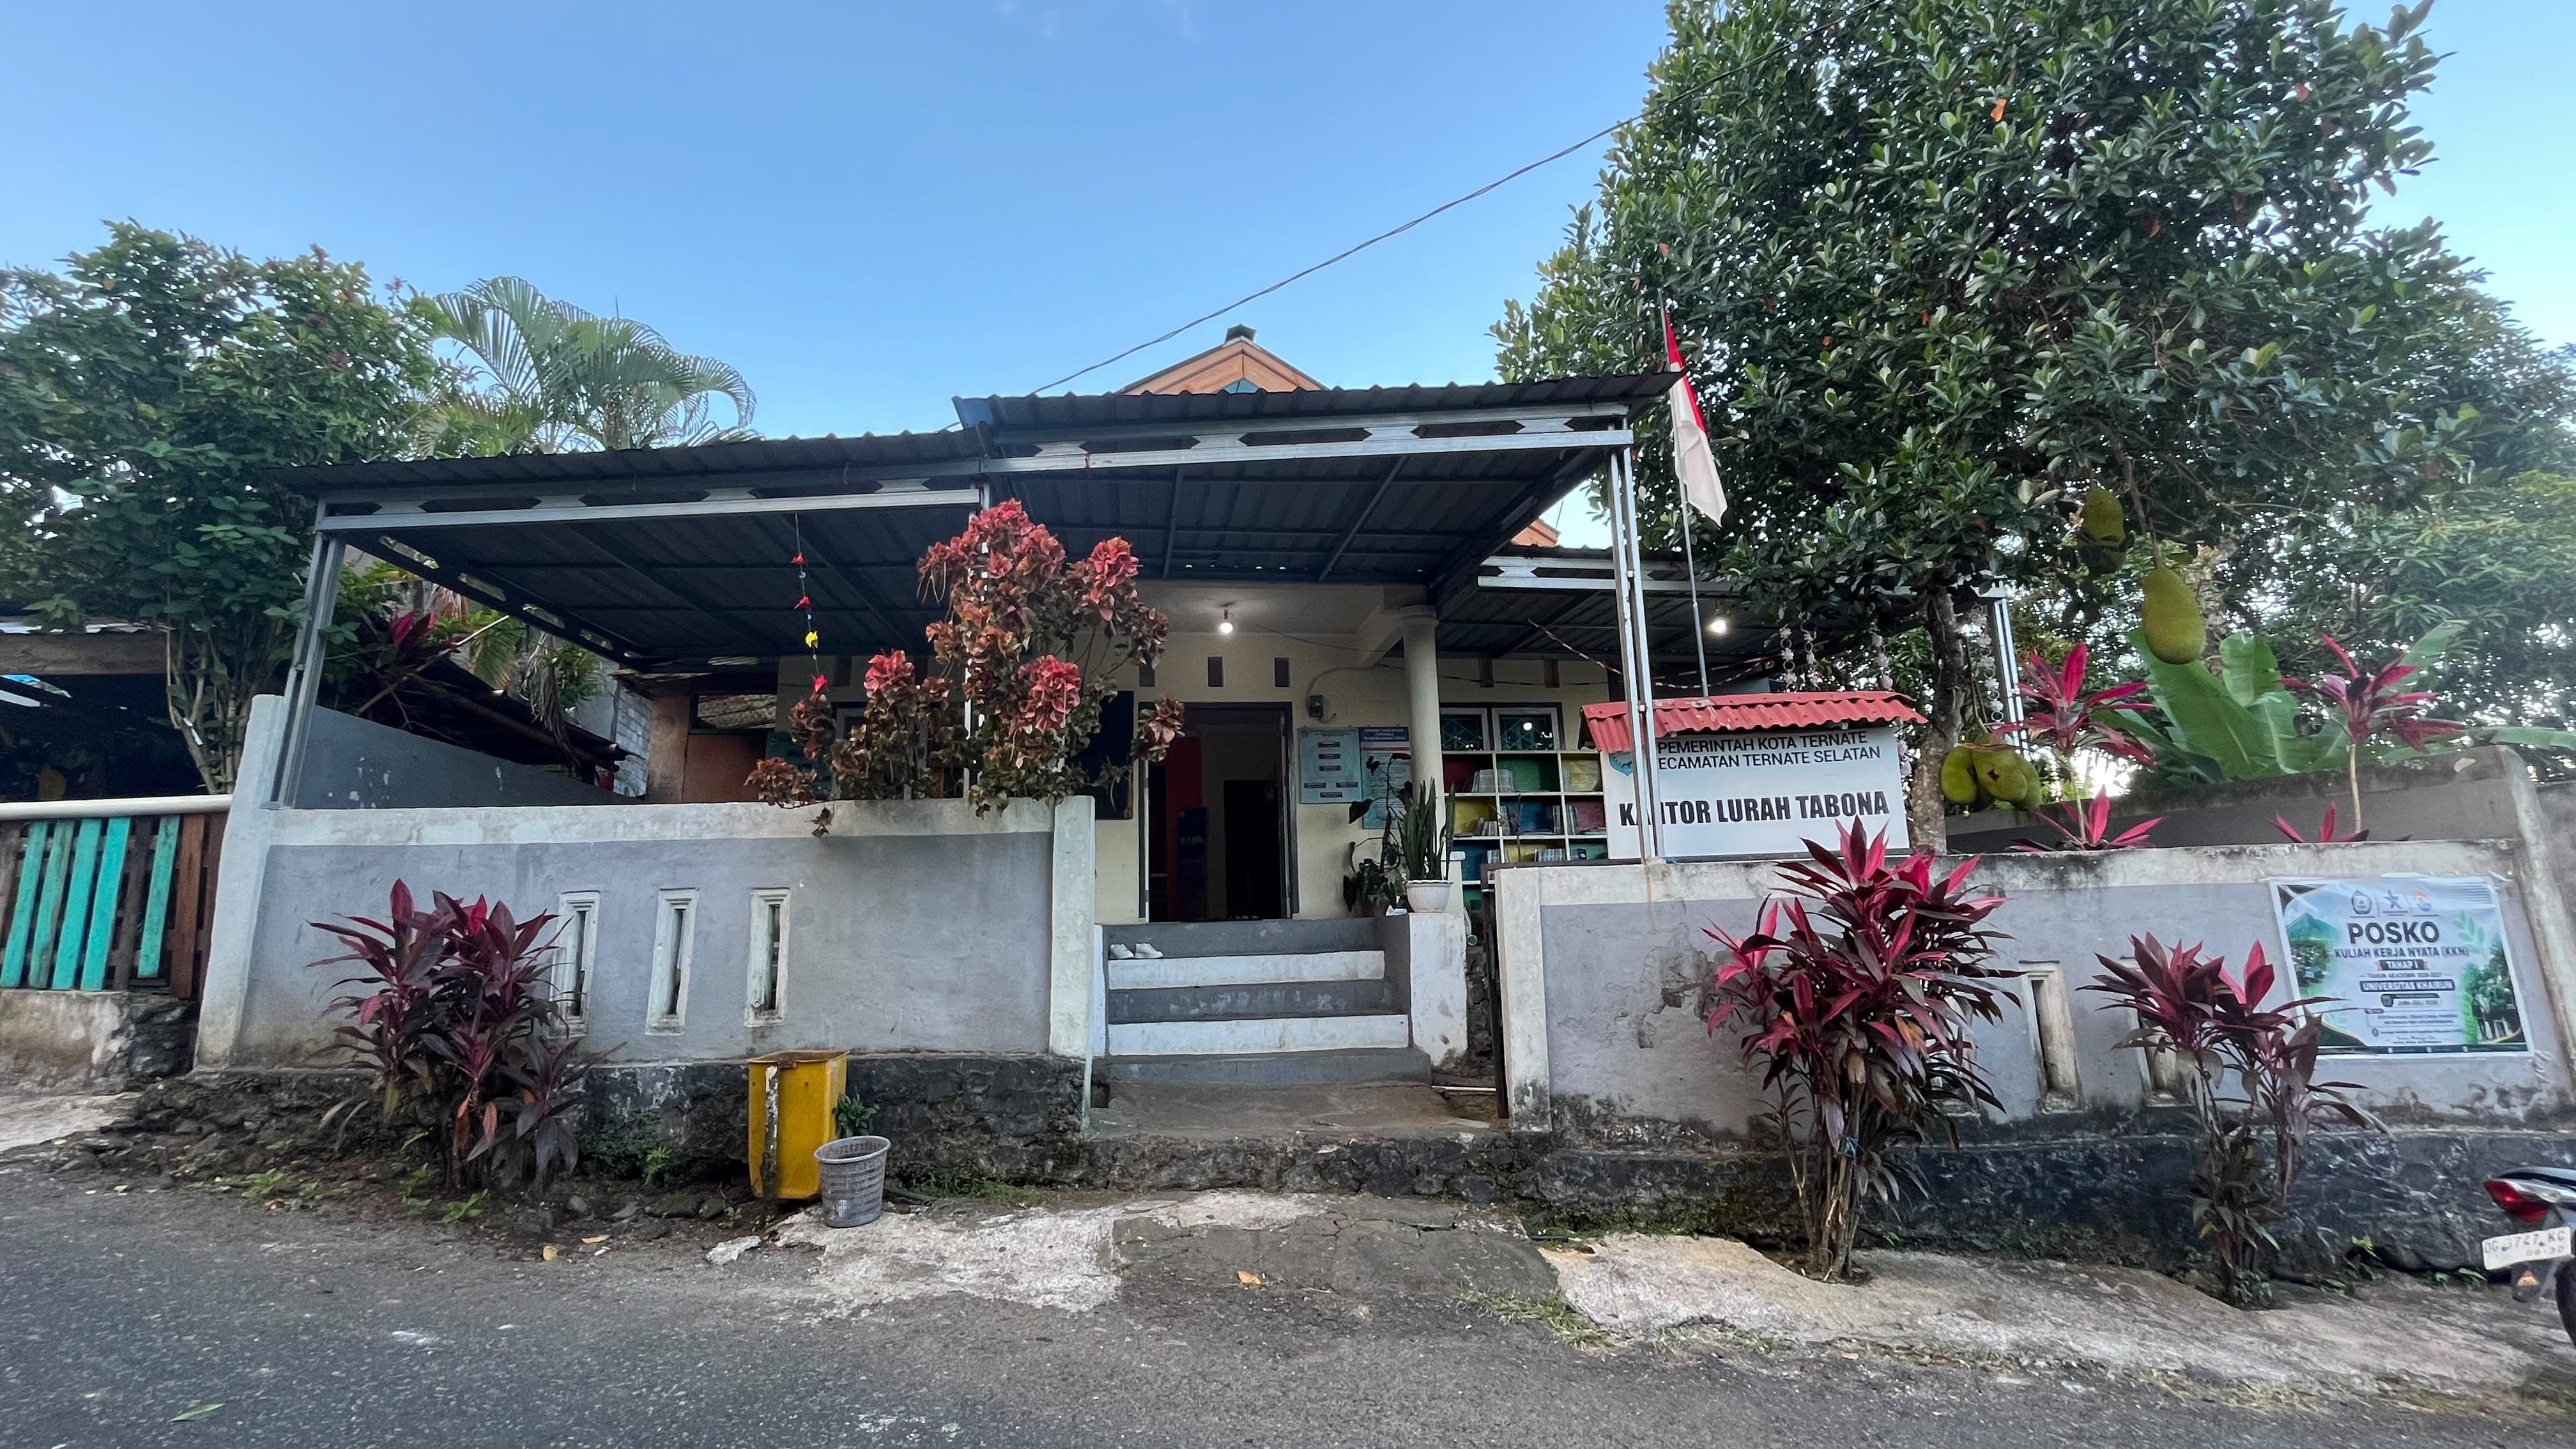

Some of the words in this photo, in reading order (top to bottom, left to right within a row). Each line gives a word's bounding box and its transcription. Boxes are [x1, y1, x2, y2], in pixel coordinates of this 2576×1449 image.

[1657, 738, 1754, 754] PEMERINTAH
[1758, 736, 1797, 750] KOTA
[1799, 731, 1867, 747] TERNATE
[1658, 755, 1739, 770] ECAMATAN
[1743, 751, 1811, 767] TERNATE
[1814, 746, 1880, 763] SELATAN
[1619, 800, 1712, 826] KTOR
[1717, 797, 1791, 822] LURAH
[1795, 791, 1890, 818] TABONA
[2347, 921, 2439, 944] POSKO
[2334, 948, 2371, 958] KULIAH
[2373, 948, 2405, 958] KERJA
[2408, 947, 2439, 958] NYATA
[2441, 946, 2469, 956] (KKN)
[2363, 981, 2416, 990] UNIVERSITAS
